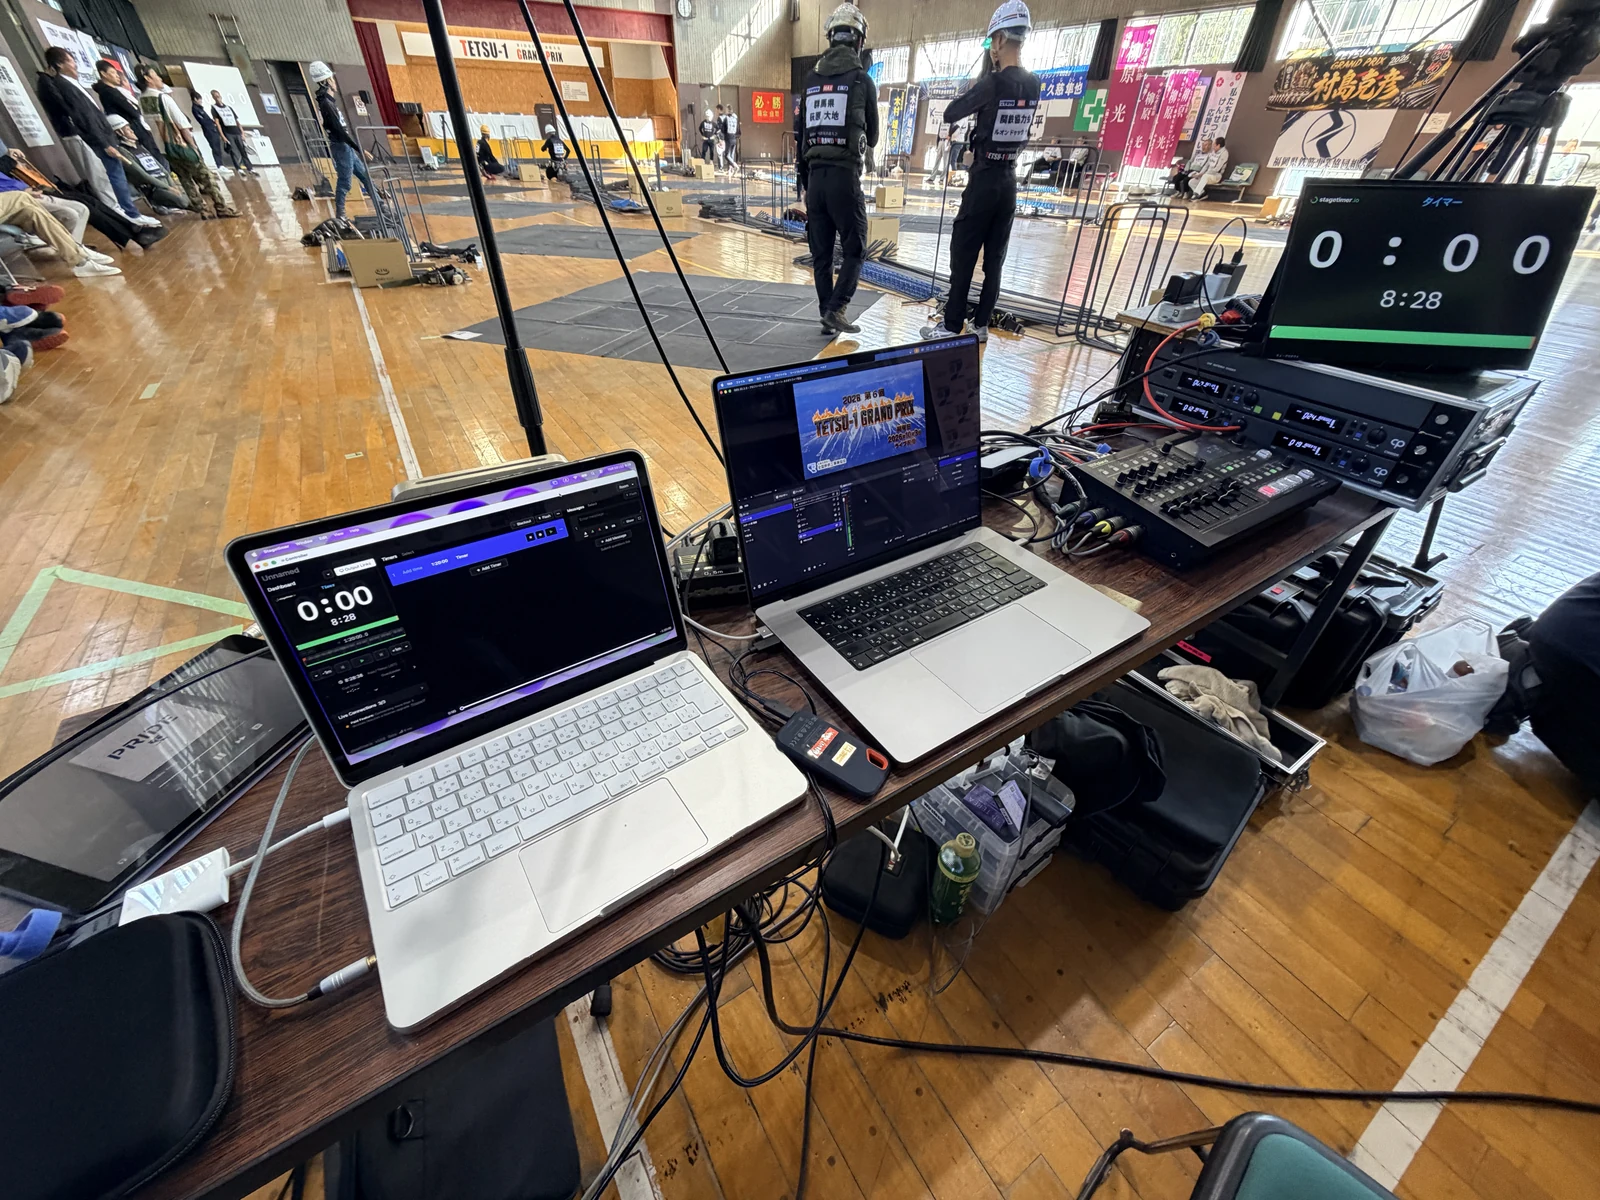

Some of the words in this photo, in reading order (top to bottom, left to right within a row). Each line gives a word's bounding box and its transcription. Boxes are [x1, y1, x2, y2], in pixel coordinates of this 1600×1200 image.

[460, 40, 509, 59] TETSU-1
[516, 48, 542, 61] GRAN
[546, 51, 564, 62] PRIX
[1331, 59, 1363, 70] GRAND
[1363, 57, 1387, 66] PRIX
[1222, 88, 1238, 122] 私たちは
[824, 110, 839, 120] 大地
[1110, 103, 1126, 123] 光
[1156, 136, 1166, 150] 光
[1422, 196, 1463, 207] タイマー
[1380, 290, 1442, 310] 8:28
[814, 411, 858, 438] TETSU-1
[860, 404, 893, 428] GRAND
[894, 399, 914, 419] PRIX
[264, 545, 290, 554] Stagetimer
[285, 552, 308, 562] Controller
[431, 558, 448, 566] 1:20:00
[344, 564, 360, 572] Output
[360, 561, 372, 569] Links
[262, 568, 300, 582] Unnamed
[267, 581, 296, 592] Dashboard
[297, 586, 373, 622] 0:00
[330, 613, 356, 626] 8:28
[348, 703, 377, 716] Connections
[107, 714, 178, 760] PRIDE
[384, 848, 404, 860] control
[492, 844, 504, 853] ABC
[456, 856, 480, 872] command
[425, 876, 442, 886] option
